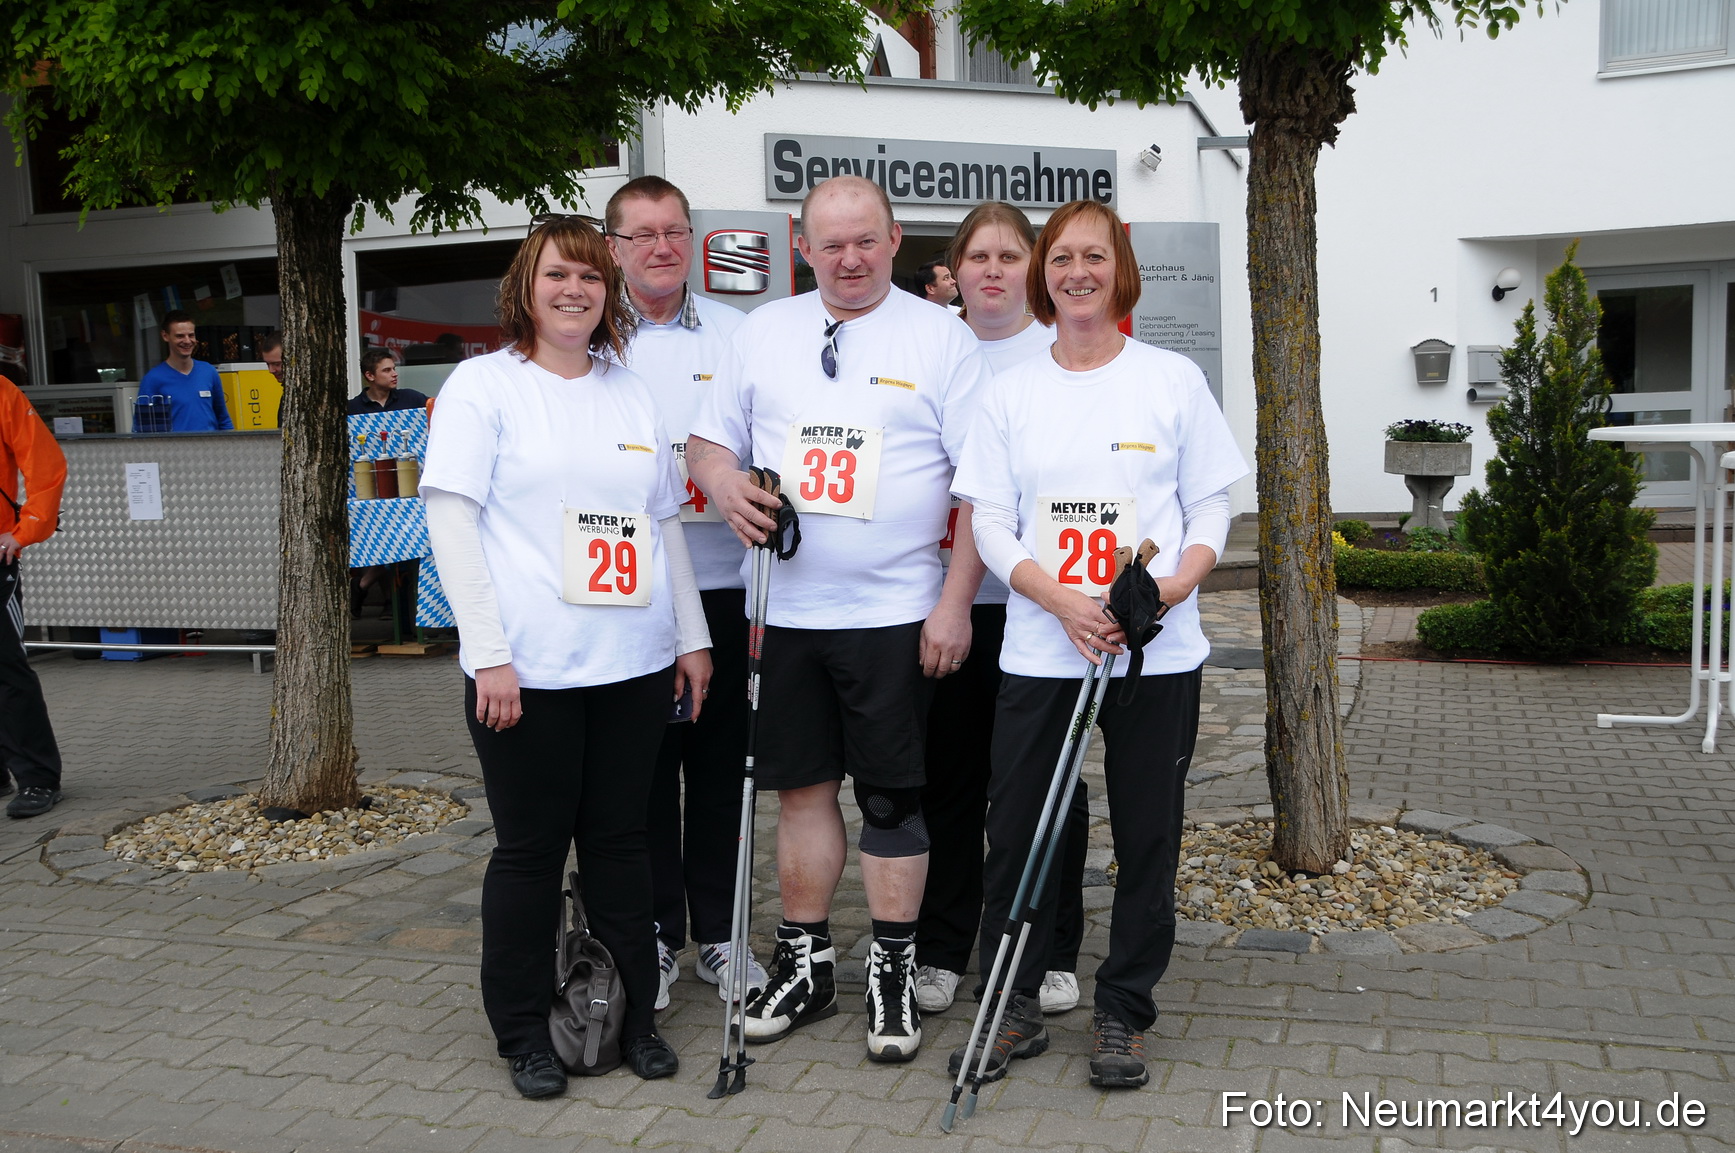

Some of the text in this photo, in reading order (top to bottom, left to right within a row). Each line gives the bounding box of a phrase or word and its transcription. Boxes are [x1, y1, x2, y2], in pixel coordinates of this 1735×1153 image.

[1139, 264, 1185, 272] Autohaus
[1140, 274, 1215, 284] Gerhart & Jänig
[1430, 287, 1438, 302] 1
[1139, 330, 1184, 338] Finanzierung
[1191, 330, 1216, 338] Leasing
[800, 426, 844, 438] MEYER
[800, 436, 843, 446] WERBUNG
[799, 448, 857, 504] 33
[1050, 502, 1097, 514] MEYER
[578, 513, 619, 527] MEYER
[1050, 514, 1098, 523] WERBUNG
[578, 524, 620, 535] WERBUNG
[1058, 528, 1117, 586] 28
[588, 538, 637, 596] 29
